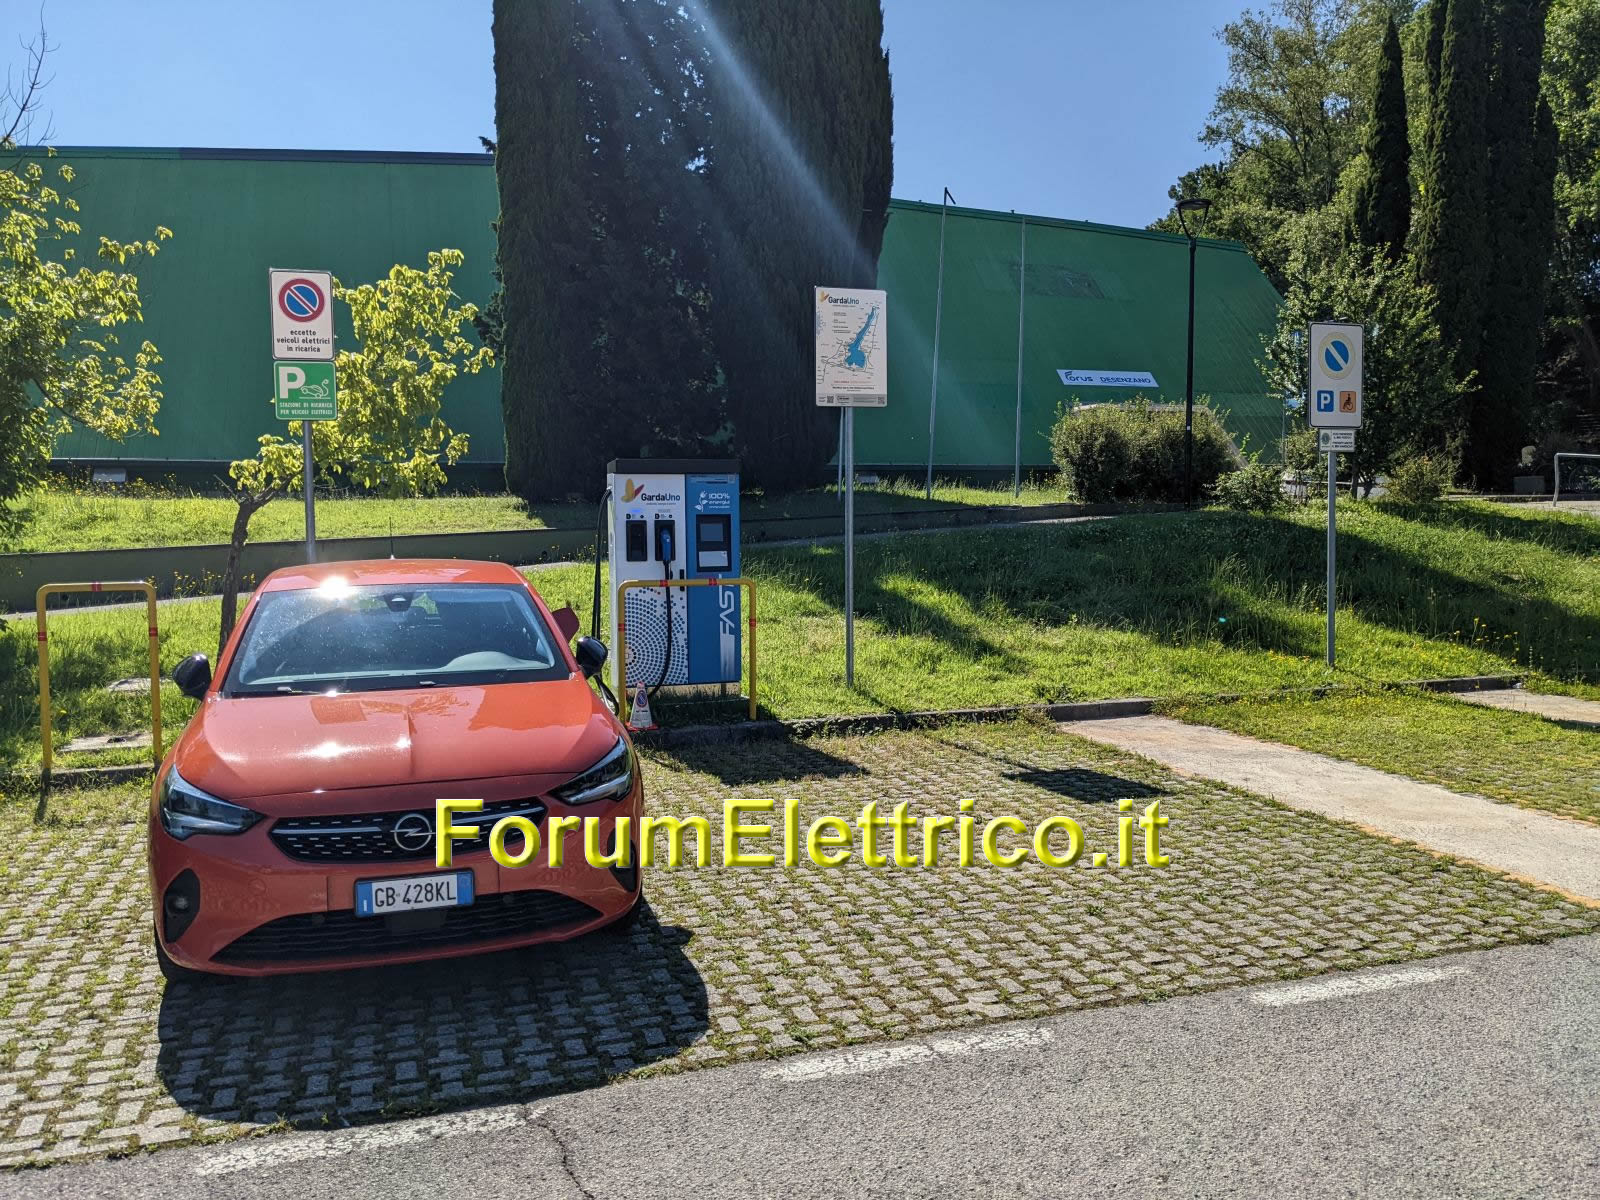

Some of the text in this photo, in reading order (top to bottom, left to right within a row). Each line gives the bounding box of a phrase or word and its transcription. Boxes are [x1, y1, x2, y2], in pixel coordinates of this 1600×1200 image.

[828, 296, 860, 305] GardaUno
[301, 337, 330, 345] elettrici
[295, 345, 321, 353] ricarica
[278, 366, 306, 399] P
[1099, 376, 1152, 384] DESENZANO
[1320, 392, 1331, 410] P
[641, 492, 681, 501] GardaUno
